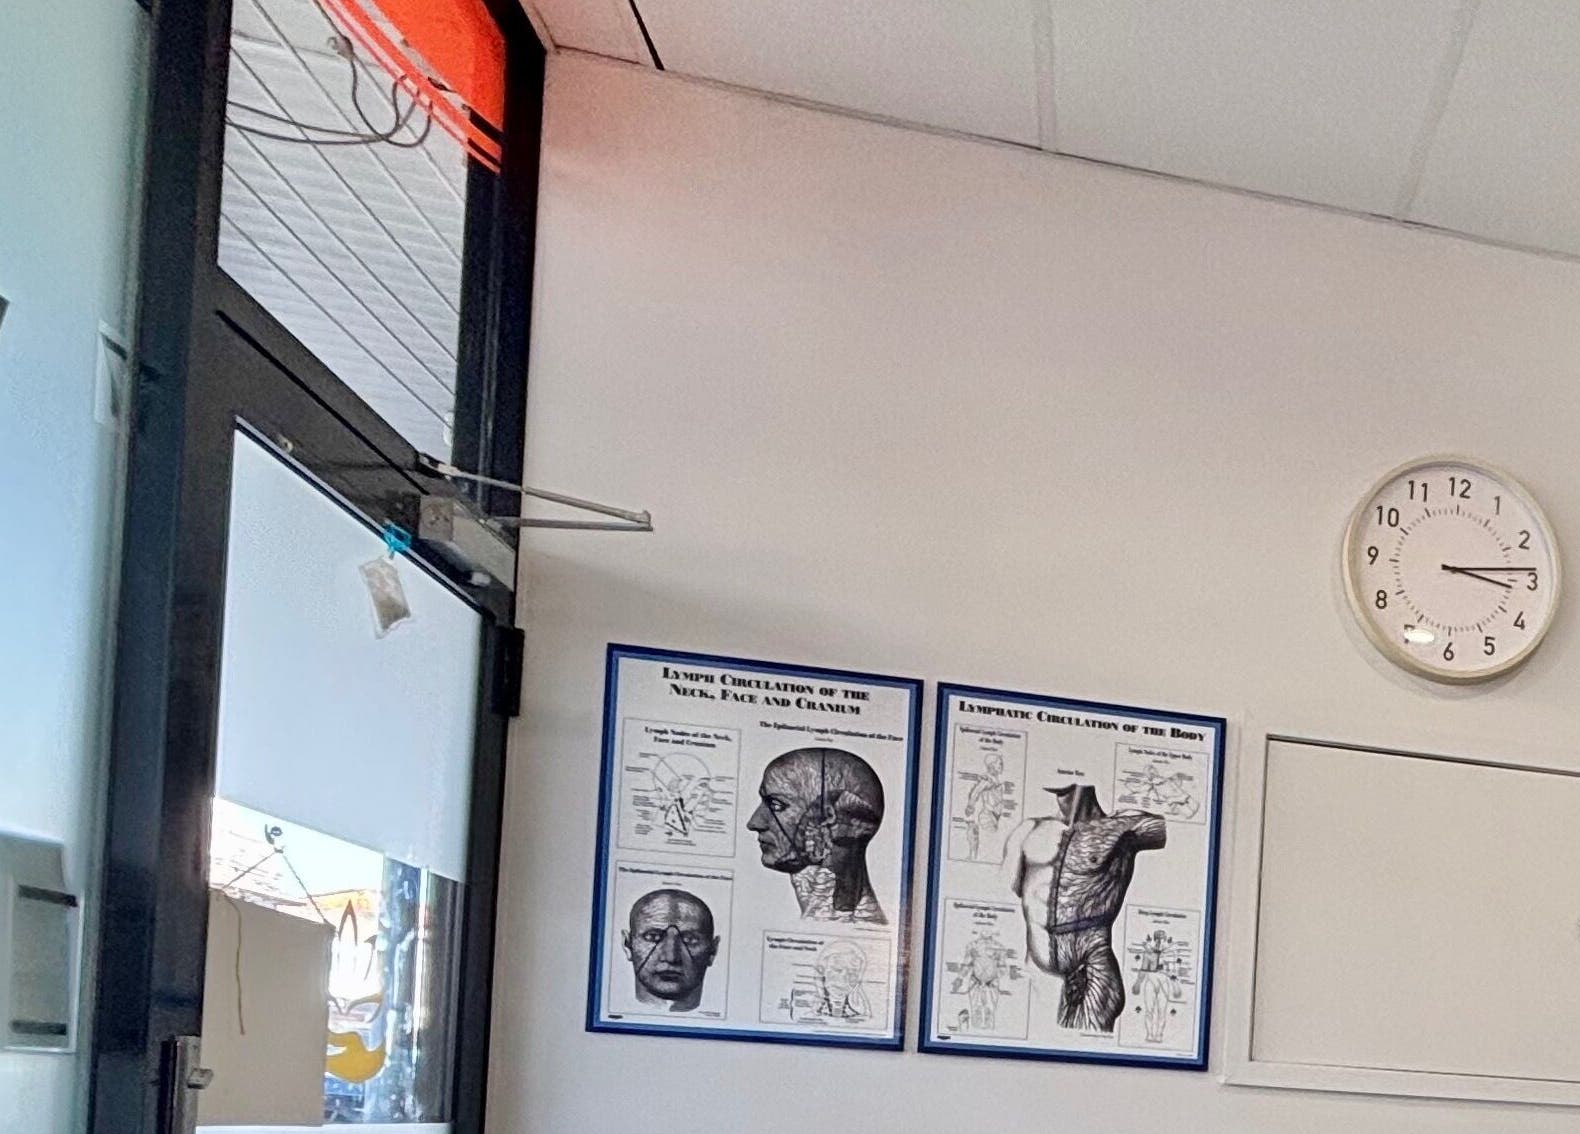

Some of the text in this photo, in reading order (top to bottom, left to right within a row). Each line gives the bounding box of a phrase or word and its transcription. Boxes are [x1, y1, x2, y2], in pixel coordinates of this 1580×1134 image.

[1408, 480, 1428, 502] 11
[1449, 477, 1471, 499] 12
[1494, 496, 1501, 515] 1
[1376, 506, 1400, 528] 10
[1518, 530, 1531, 550] 2
[1367, 546, 1379, 565] 9
[1527, 572, 1538, 591] 3
[1375, 590, 1387, 609] 8
[1513, 611, 1526, 630] 4
[1443, 642, 1455, 661] 6
[1484, 636, 1496, 656] 5
[662, 667, 870, 701] LYMPH CIRCULATION OF THE
[721, 689, 757, 704] FACE
[761, 695, 791, 708] AND
[795, 696, 860, 715] CRANIUM
[959, 700, 1206, 742] LYMPHATIC CIRCULATION OF THE BODY
